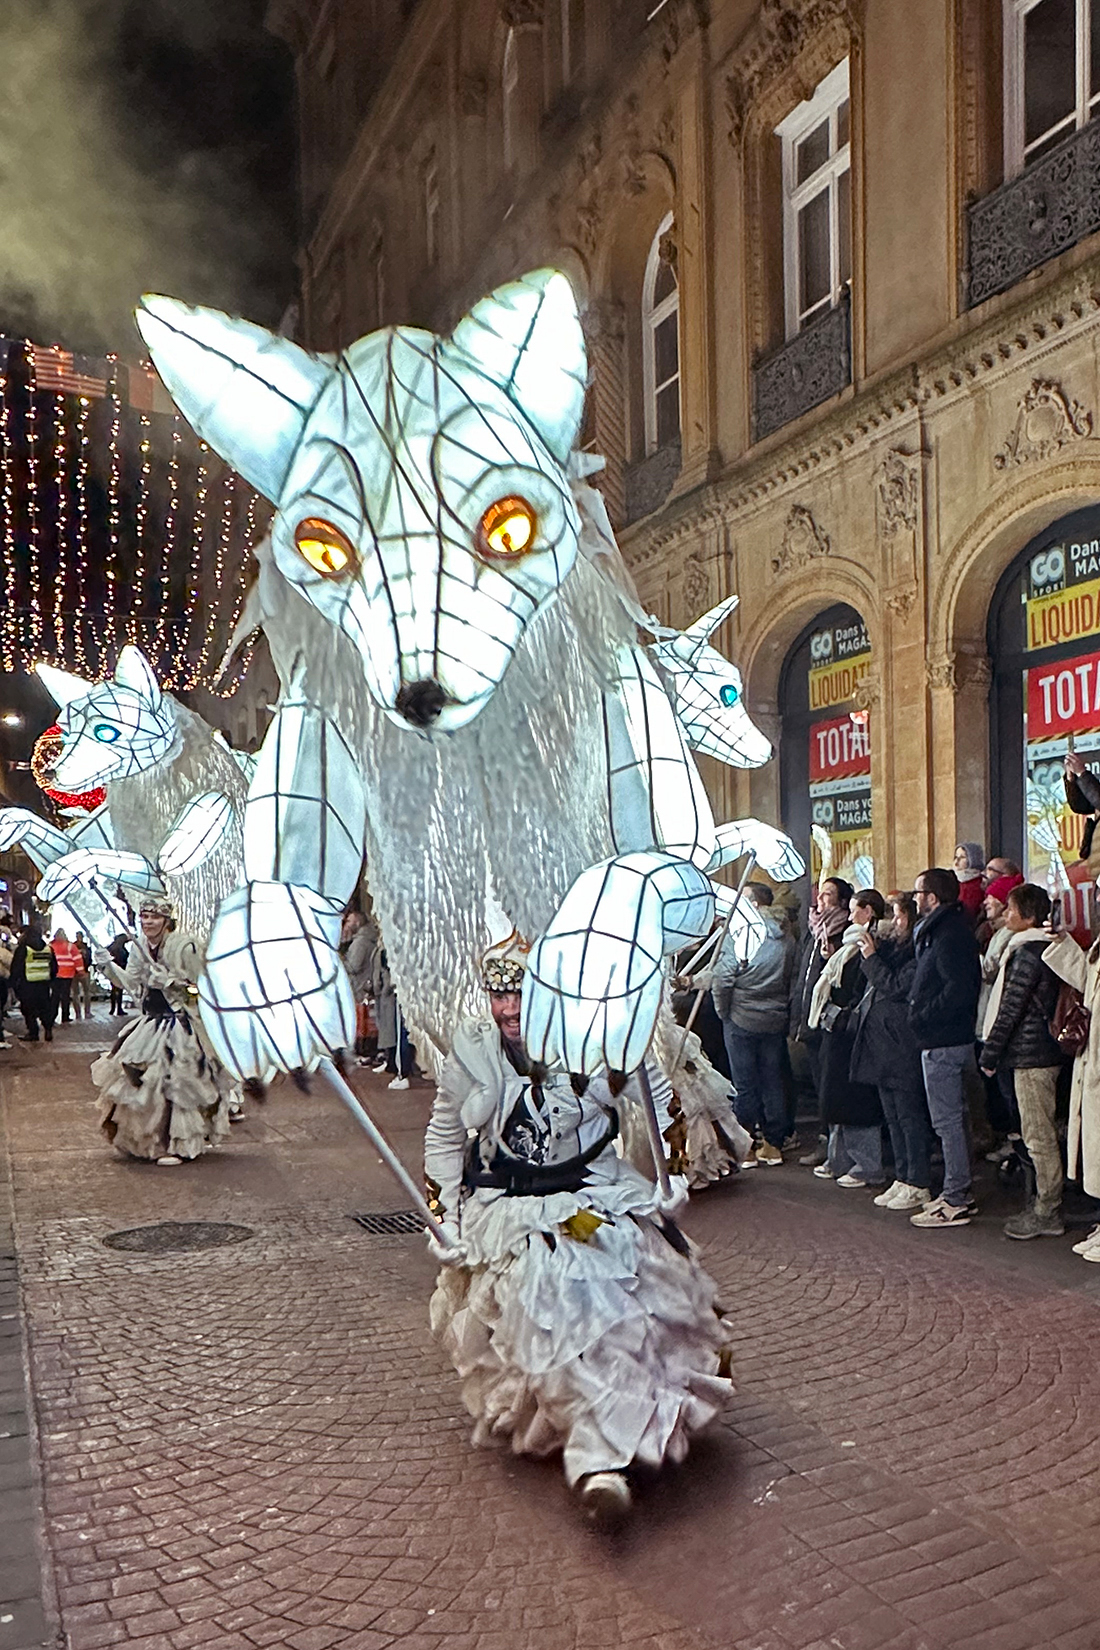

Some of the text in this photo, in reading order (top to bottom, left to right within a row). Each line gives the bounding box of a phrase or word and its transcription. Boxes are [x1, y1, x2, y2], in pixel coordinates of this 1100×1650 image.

[1071, 540, 1100, 560] Dan
[1031, 548, 1064, 585] GO
[1075, 556, 1100, 577] MA
[836, 625, 858, 642] Dans
[811, 632, 832, 659] GO
[817, 722, 871, 769] TOTAL
[813, 801, 833, 823] GO
[837, 799, 859, 813] Dans
